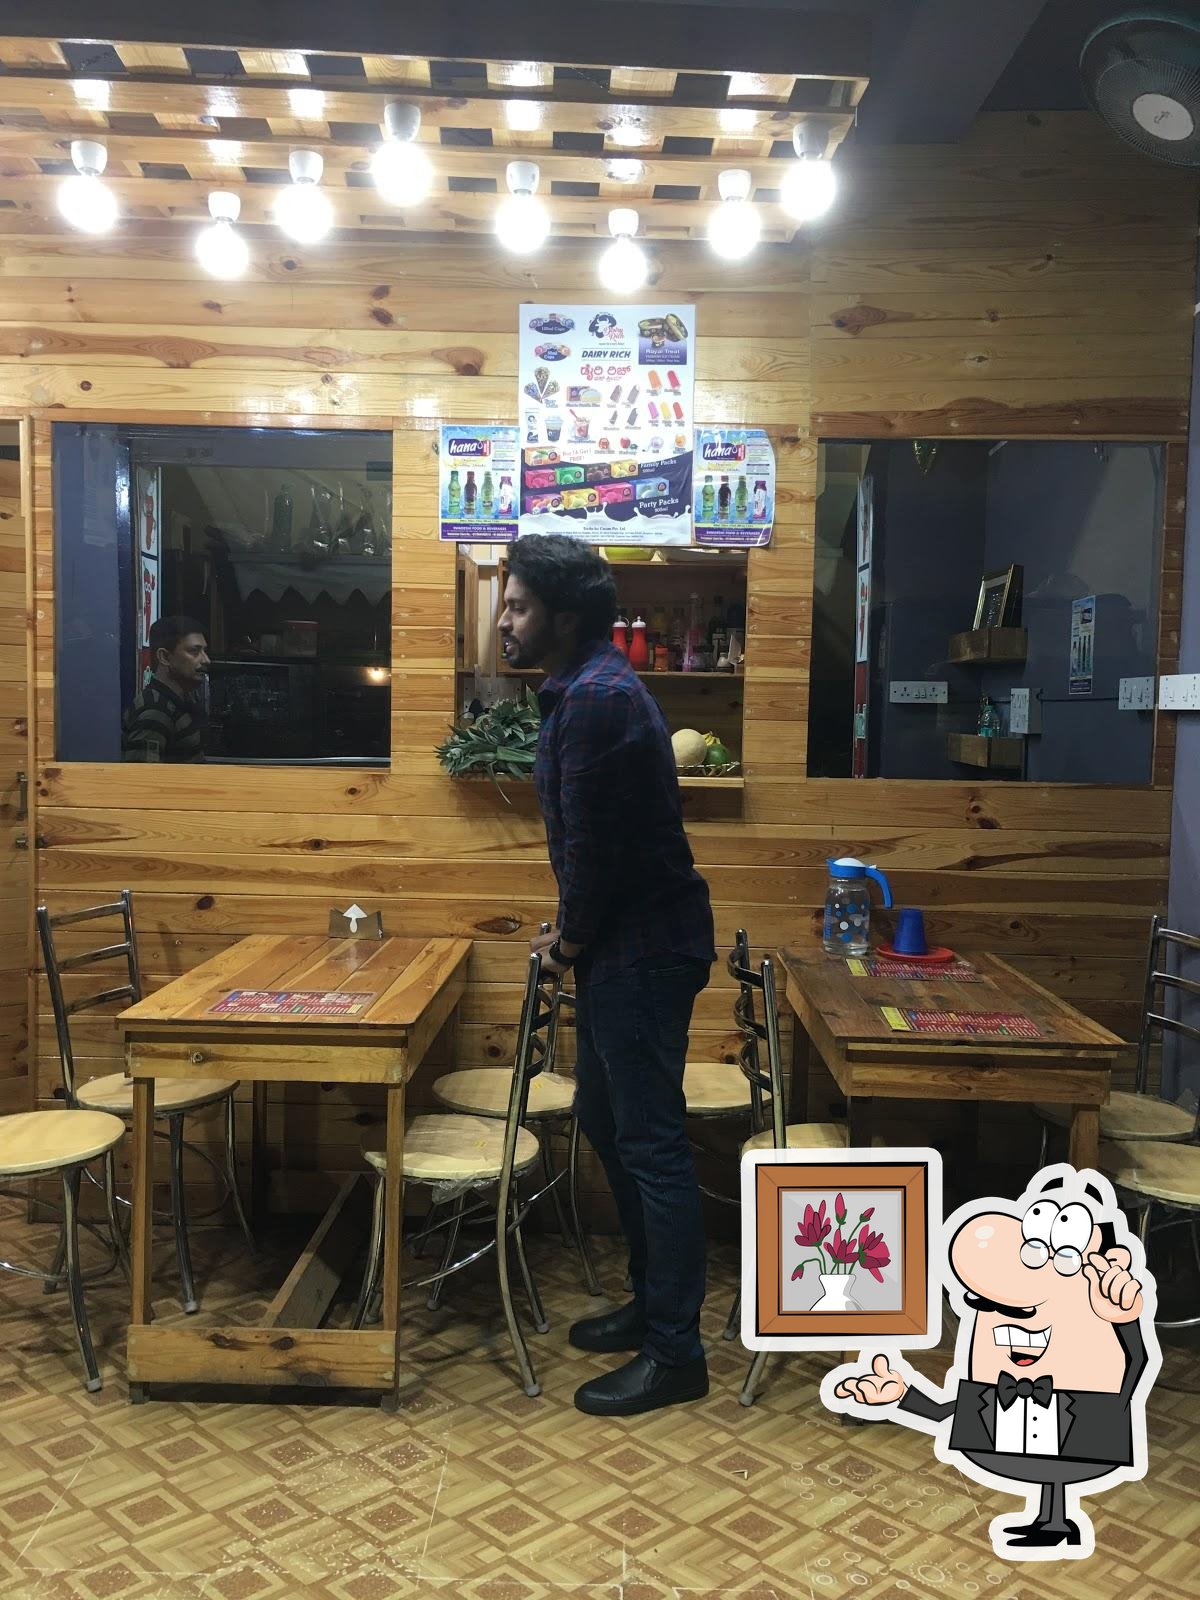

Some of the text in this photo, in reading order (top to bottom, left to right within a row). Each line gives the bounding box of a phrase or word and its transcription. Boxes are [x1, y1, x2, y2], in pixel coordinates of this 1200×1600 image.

[450, 440, 477, 454] hana
[704, 445, 731, 458] hana
[658, 498, 678, 506] Packs
